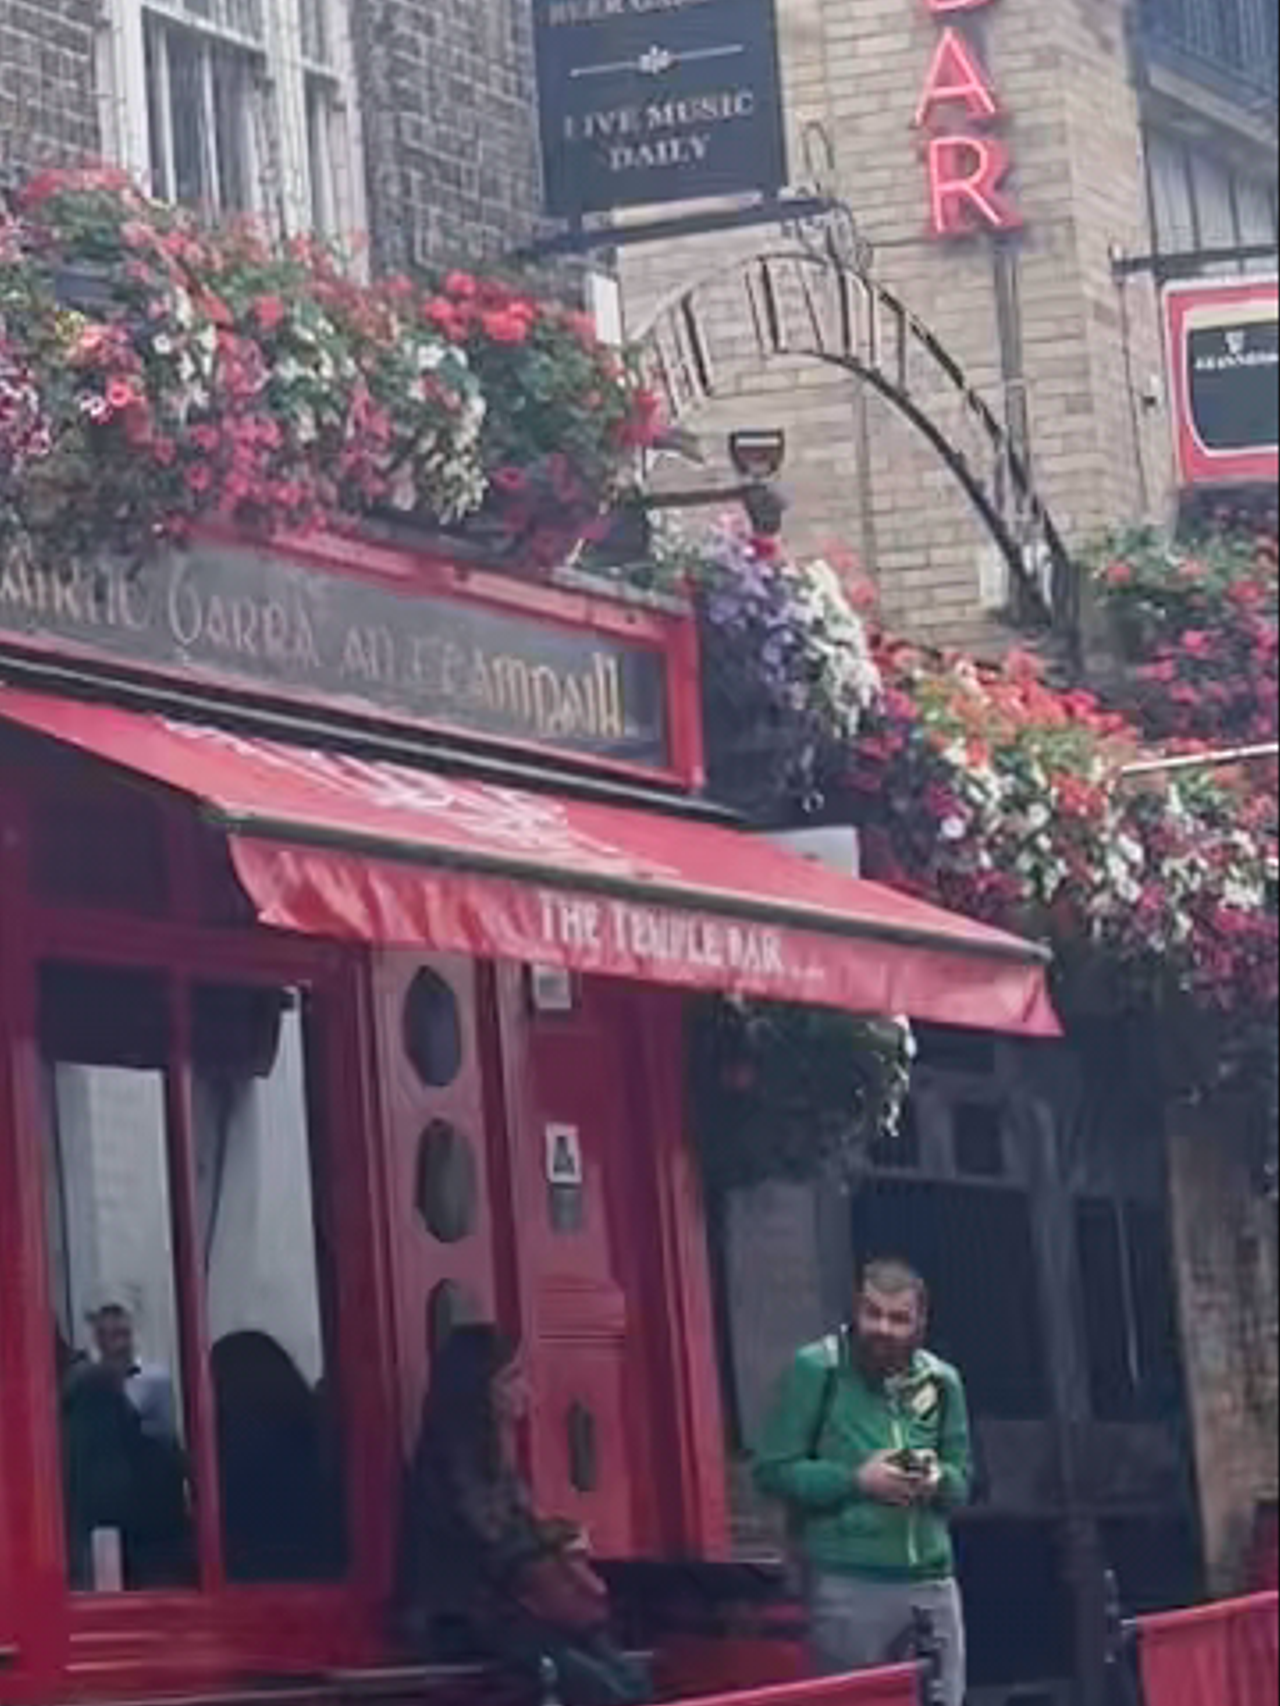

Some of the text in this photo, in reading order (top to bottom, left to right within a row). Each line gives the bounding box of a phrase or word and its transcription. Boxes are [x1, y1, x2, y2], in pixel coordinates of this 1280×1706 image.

[646, 92, 754, 129] MUSIC
[540, 890, 599, 946] THE
[609, 900, 723, 967] TEMPLE
